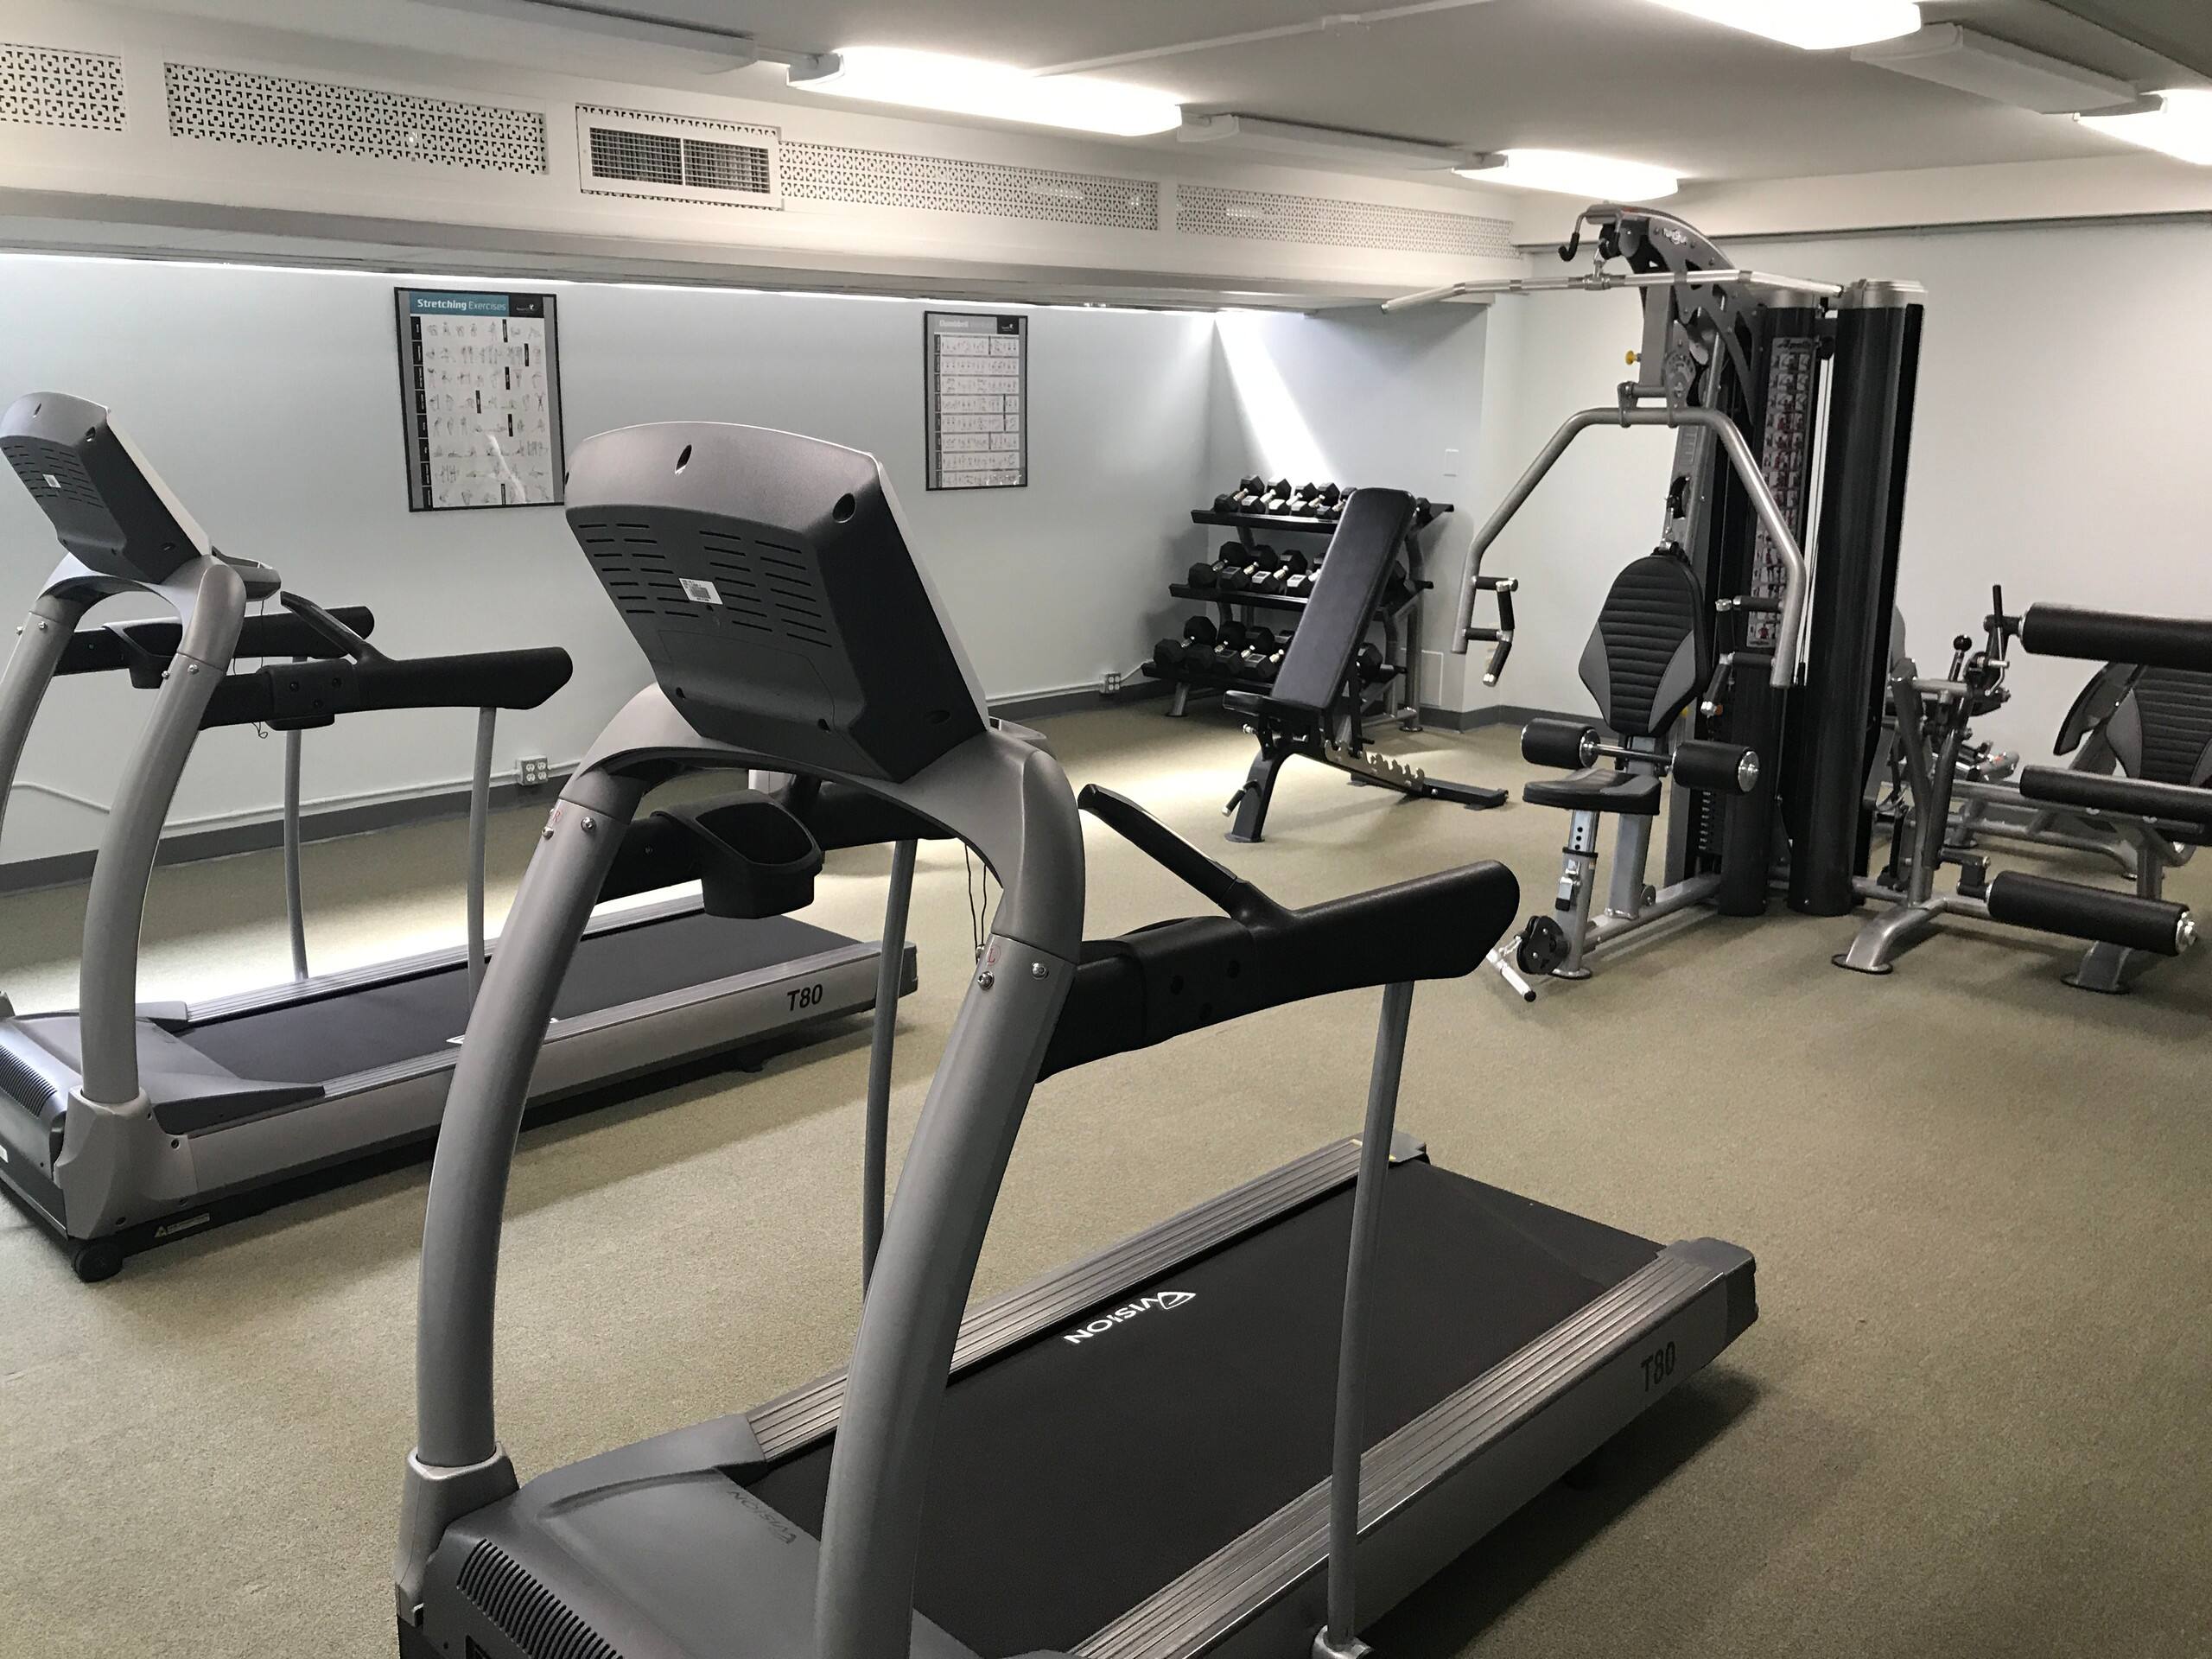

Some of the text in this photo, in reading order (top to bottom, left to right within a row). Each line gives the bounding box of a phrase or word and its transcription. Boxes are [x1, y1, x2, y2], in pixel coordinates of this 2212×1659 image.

[417, 298, 467, 311] Stretching
[468, 301, 506, 312] Exercises
[787, 983, 823, 1011] T80
[1064, 1296, 1160, 1344] VISION
[1640, 1341, 1675, 1392] T80
